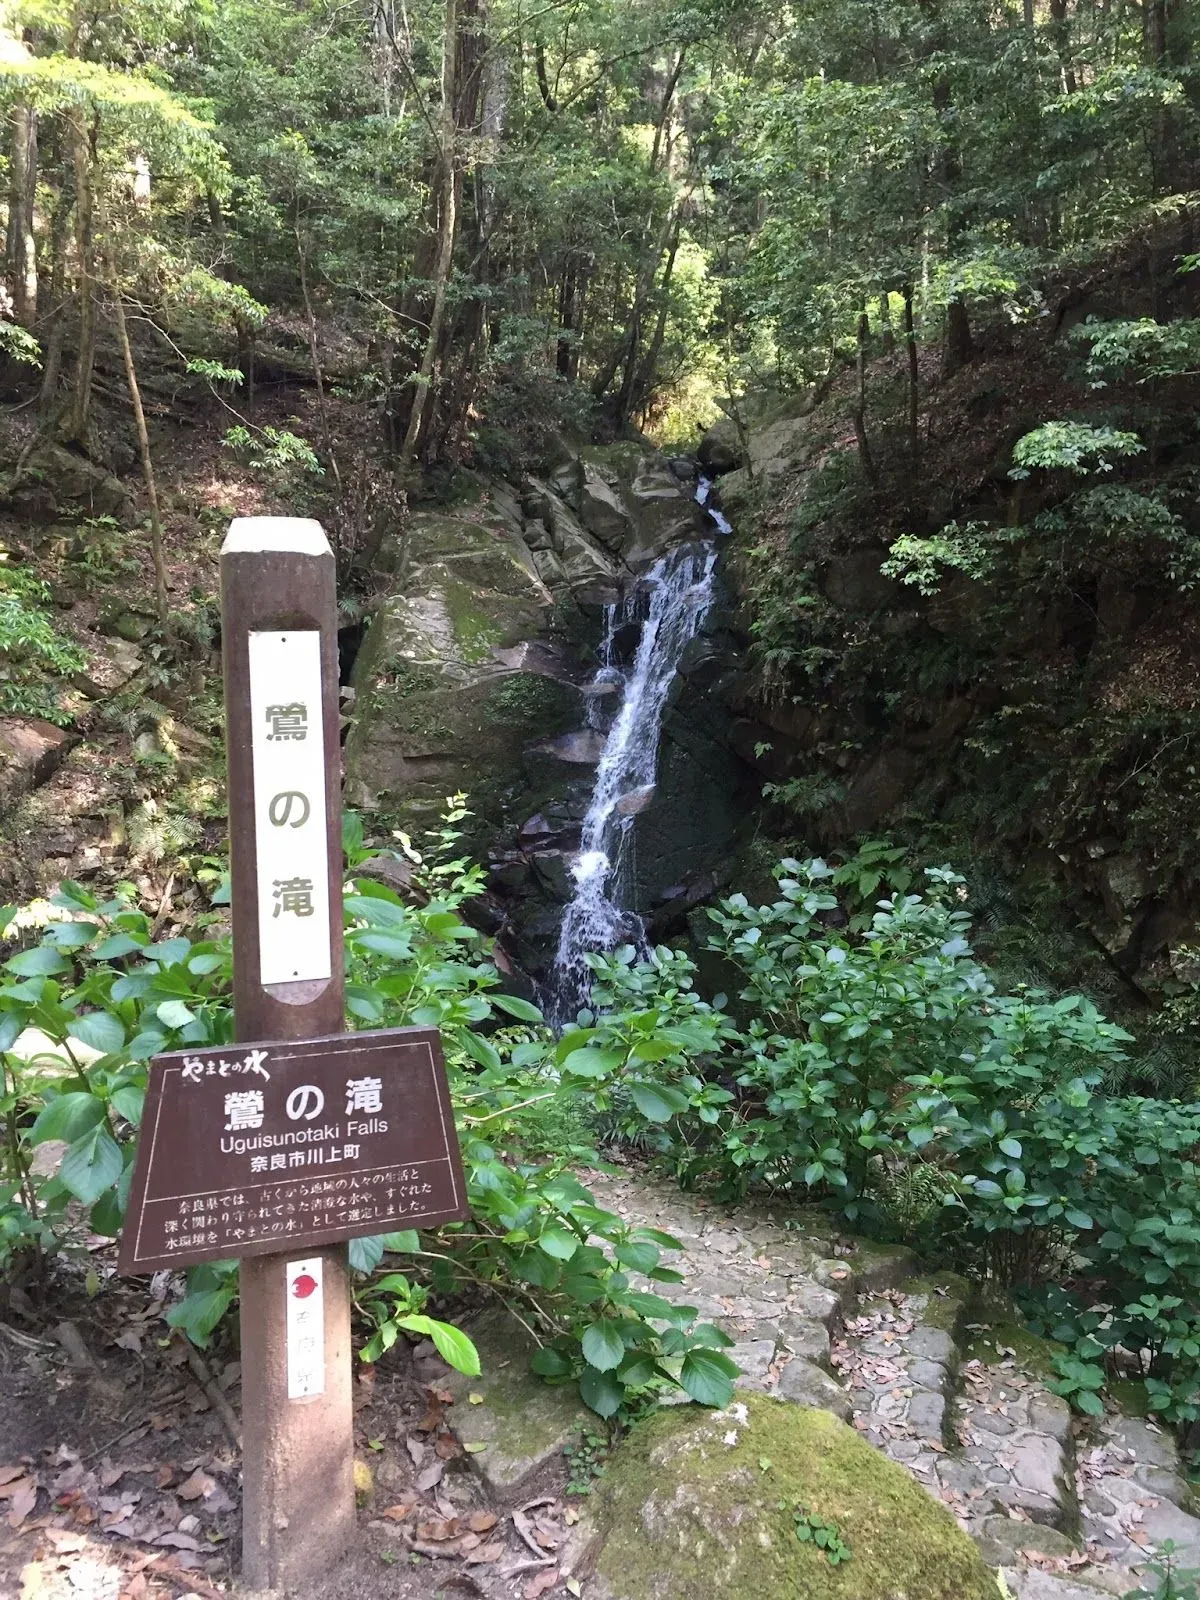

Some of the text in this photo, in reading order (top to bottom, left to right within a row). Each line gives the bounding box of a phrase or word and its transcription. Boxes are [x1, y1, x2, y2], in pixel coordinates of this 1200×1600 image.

[182, 1050, 271, 1082] やまとの水
[220, 1119, 388, 1153] Uguisunotaki Falls
[251, 1144, 360, 1173] 奈良市川上町
